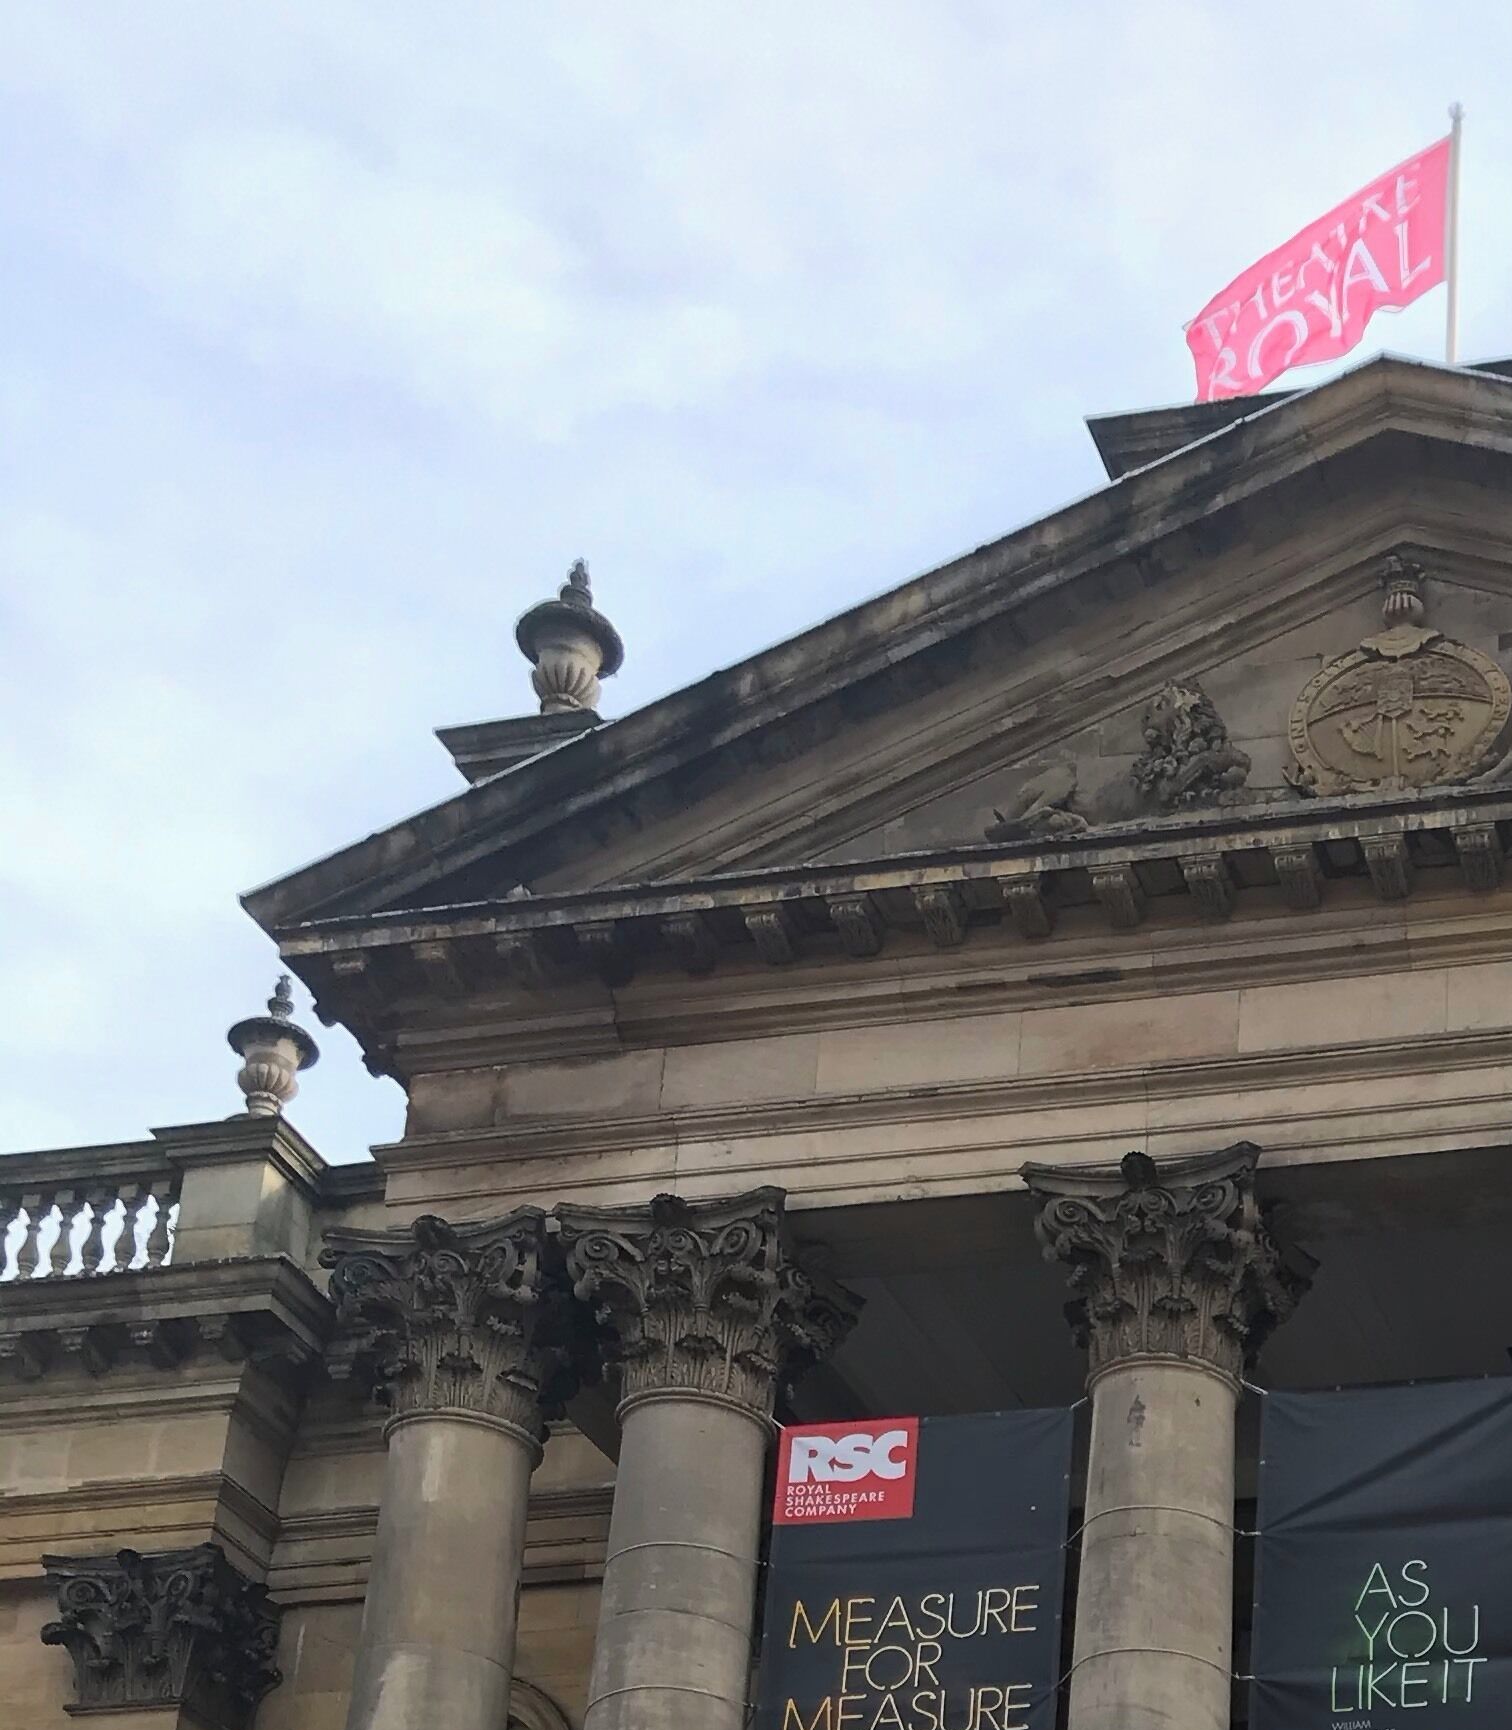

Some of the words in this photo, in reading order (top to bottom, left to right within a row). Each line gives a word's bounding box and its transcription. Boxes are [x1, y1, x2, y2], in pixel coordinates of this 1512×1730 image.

[1208, 220, 1432, 402] ROYAL
[788, 1430, 908, 1484] RSC
[784, 1503, 858, 1518] COMPANY
[785, 1490, 886, 1506] SHAKESPEARE
[786, 1484, 832, 1496] ROYAL
[1354, 1559, 1430, 1611] AS
[788, 1584, 1040, 1649] MEASURE
[1354, 1604, 1479, 1661] YOU
[841, 1641, 943, 1693] FOR
[1331, 1661, 1430, 1713] LIKE
[1442, 1657, 1488, 1704] IT
